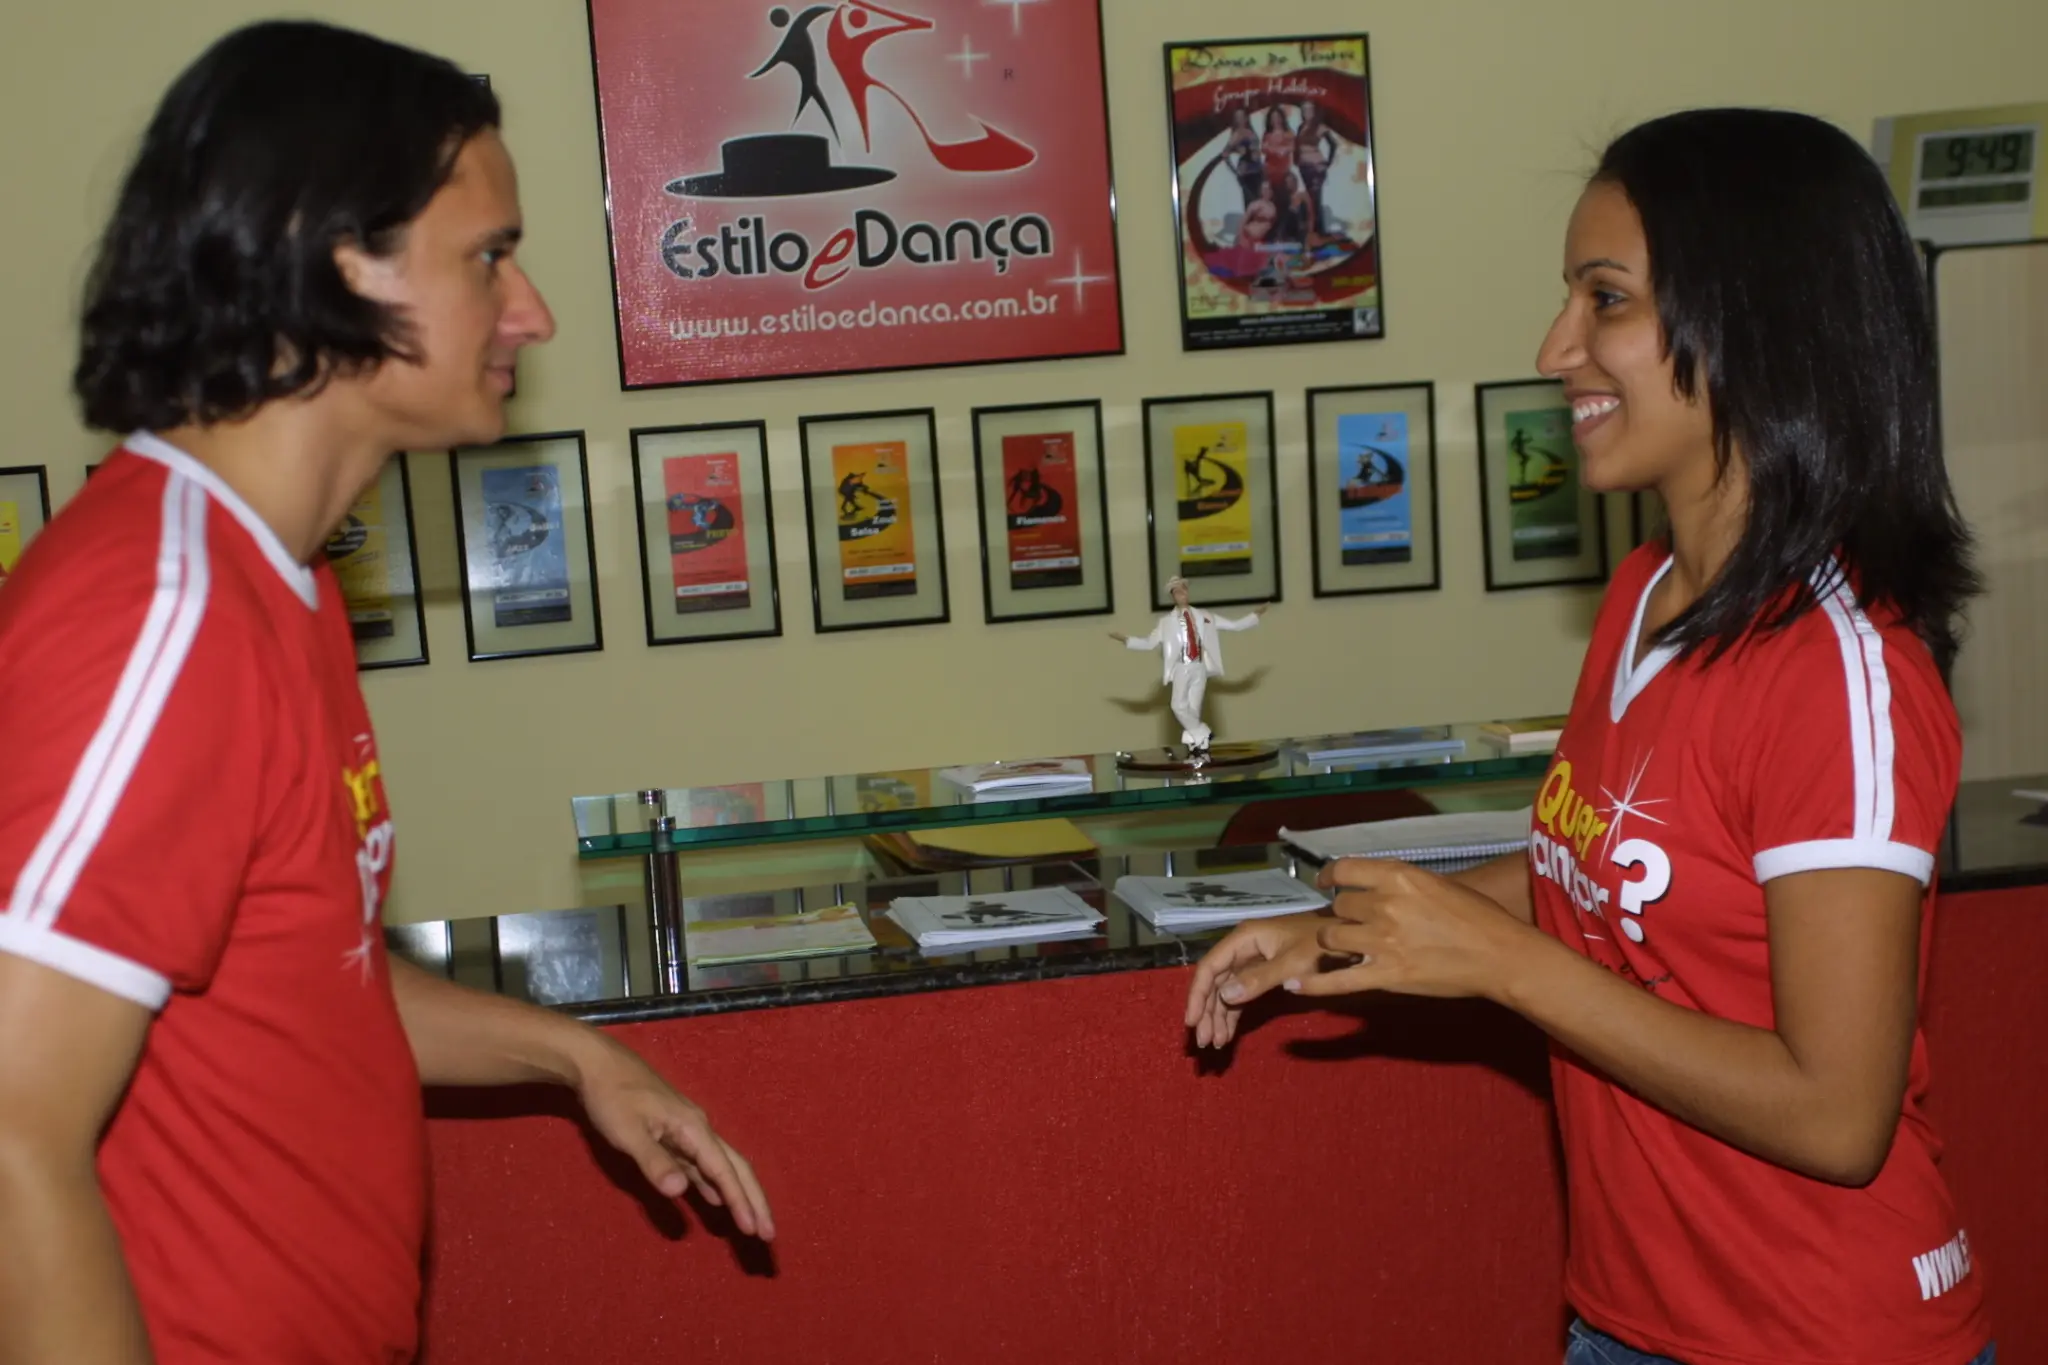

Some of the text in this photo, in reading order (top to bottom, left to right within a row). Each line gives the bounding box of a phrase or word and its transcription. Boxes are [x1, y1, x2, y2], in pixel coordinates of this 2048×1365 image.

[1947, 133, 2023, 178] 9:49
[669, 289, 1058, 340] www.estiloedanca.com.br
[1537, 760, 1608, 861] Quer
